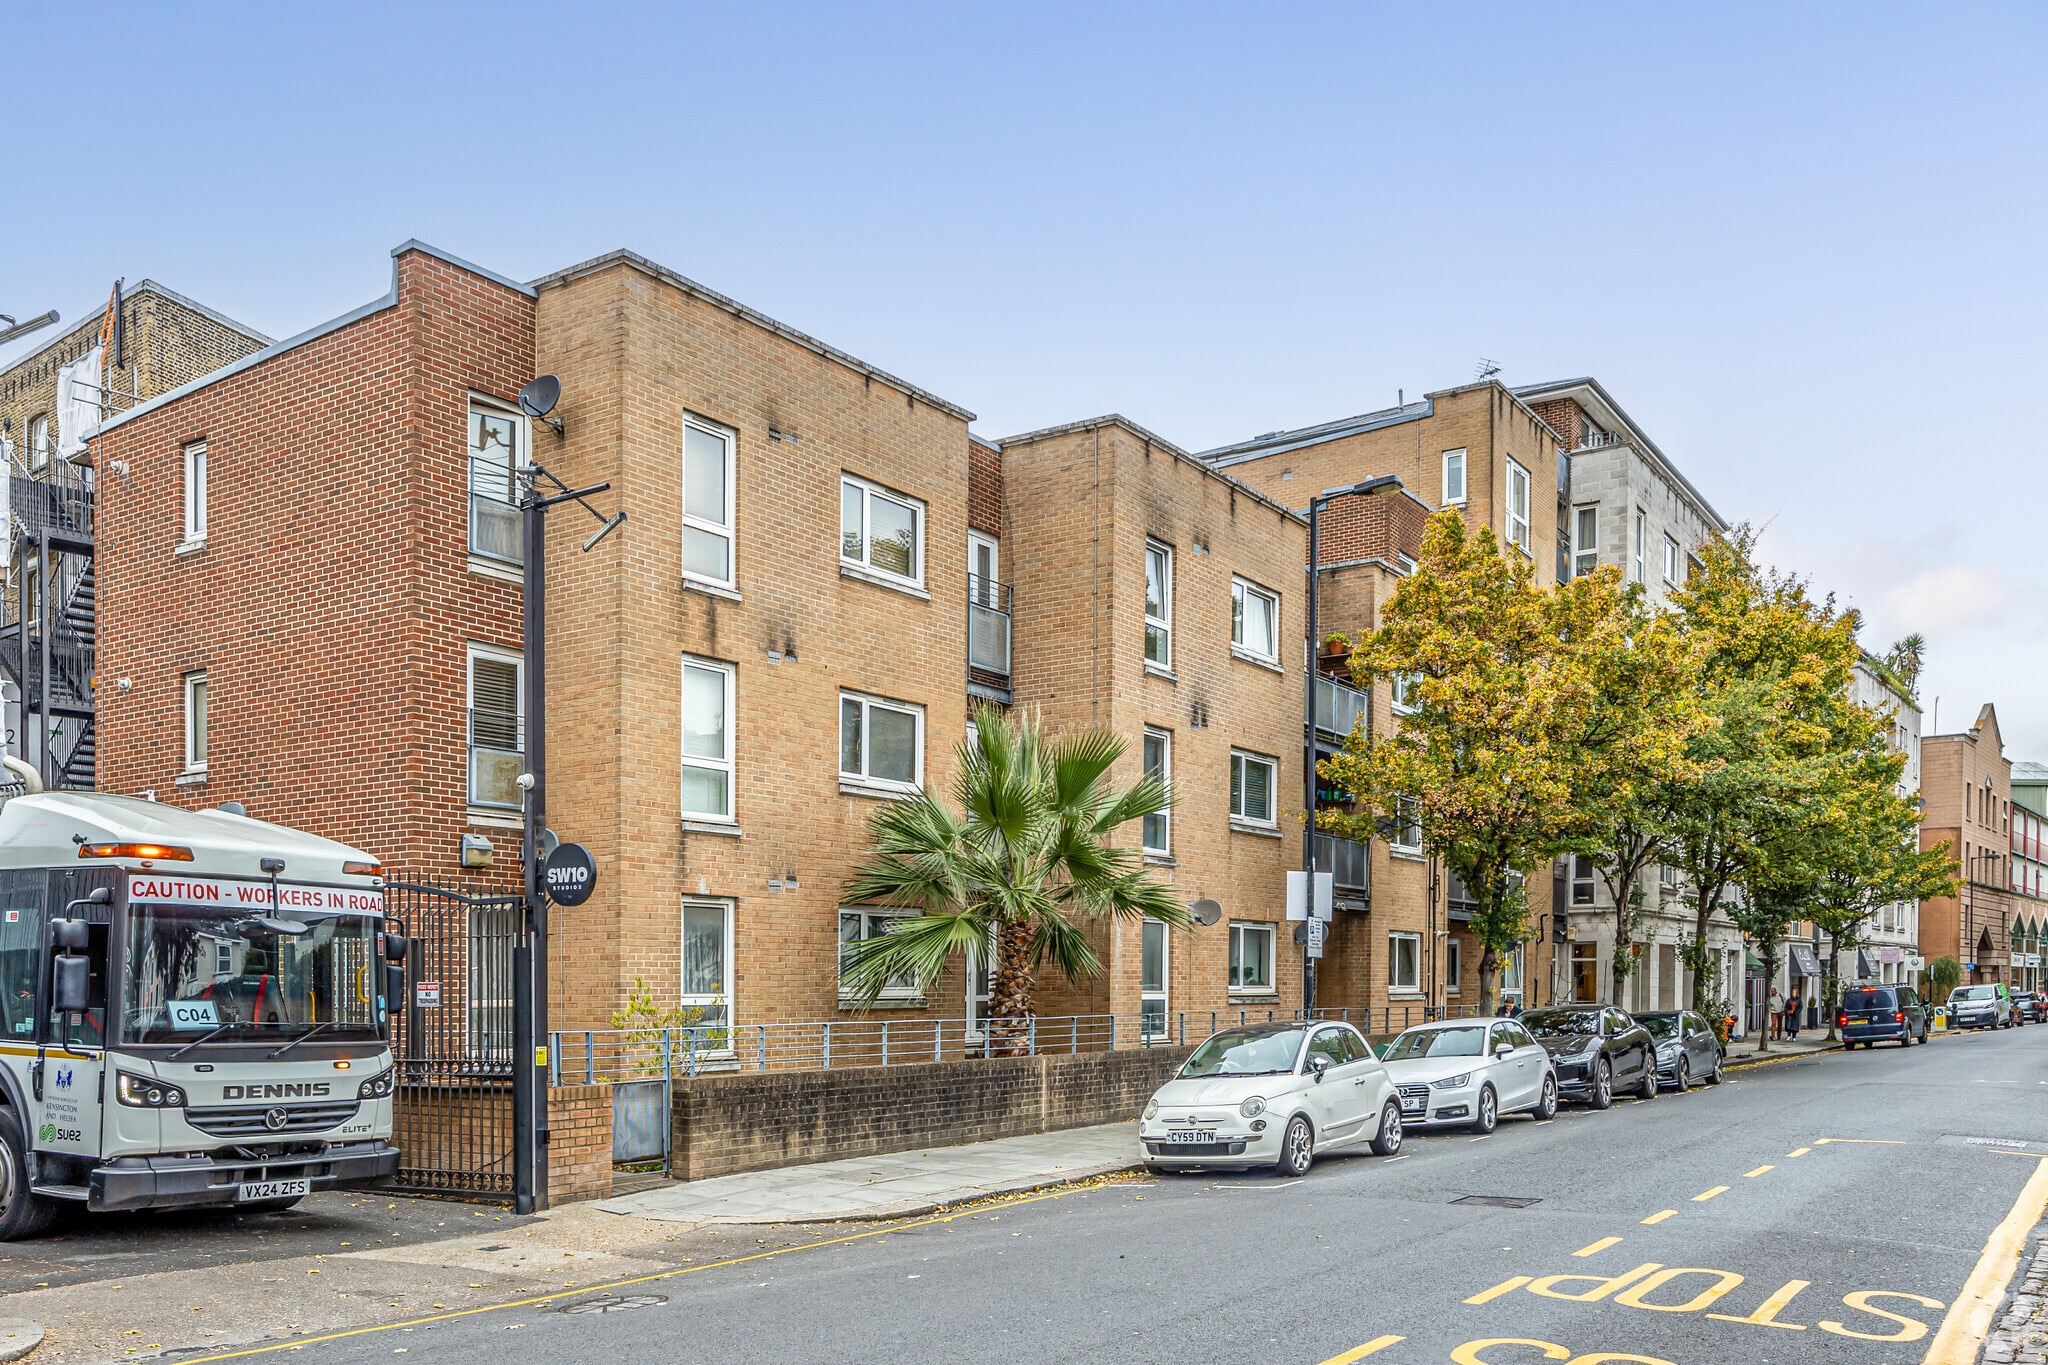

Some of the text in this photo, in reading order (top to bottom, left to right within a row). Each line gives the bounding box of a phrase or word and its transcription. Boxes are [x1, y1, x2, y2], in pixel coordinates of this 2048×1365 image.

[547, 866, 588, 884] SW10
[131, 880, 219, 900] CAUTION
[237, 886, 323, 907] WORKERS
[328, 892, 344, 909] IN
[349, 894, 383, 913] ROAD
[176, 1008, 211, 1022] C04
[223, 1082, 330, 1100] DENNIS
[46, 1102, 78, 1113] KENSINGTON
[1402, 1099, 1414, 1108] SP
[45, 1112, 57, 1120] AND
[1171, 1132, 1214, 1142] CY59 DTN
[246, 1181, 305, 1199] VX24 ZFS
[1527, 1262, 1946, 1342] STOP
